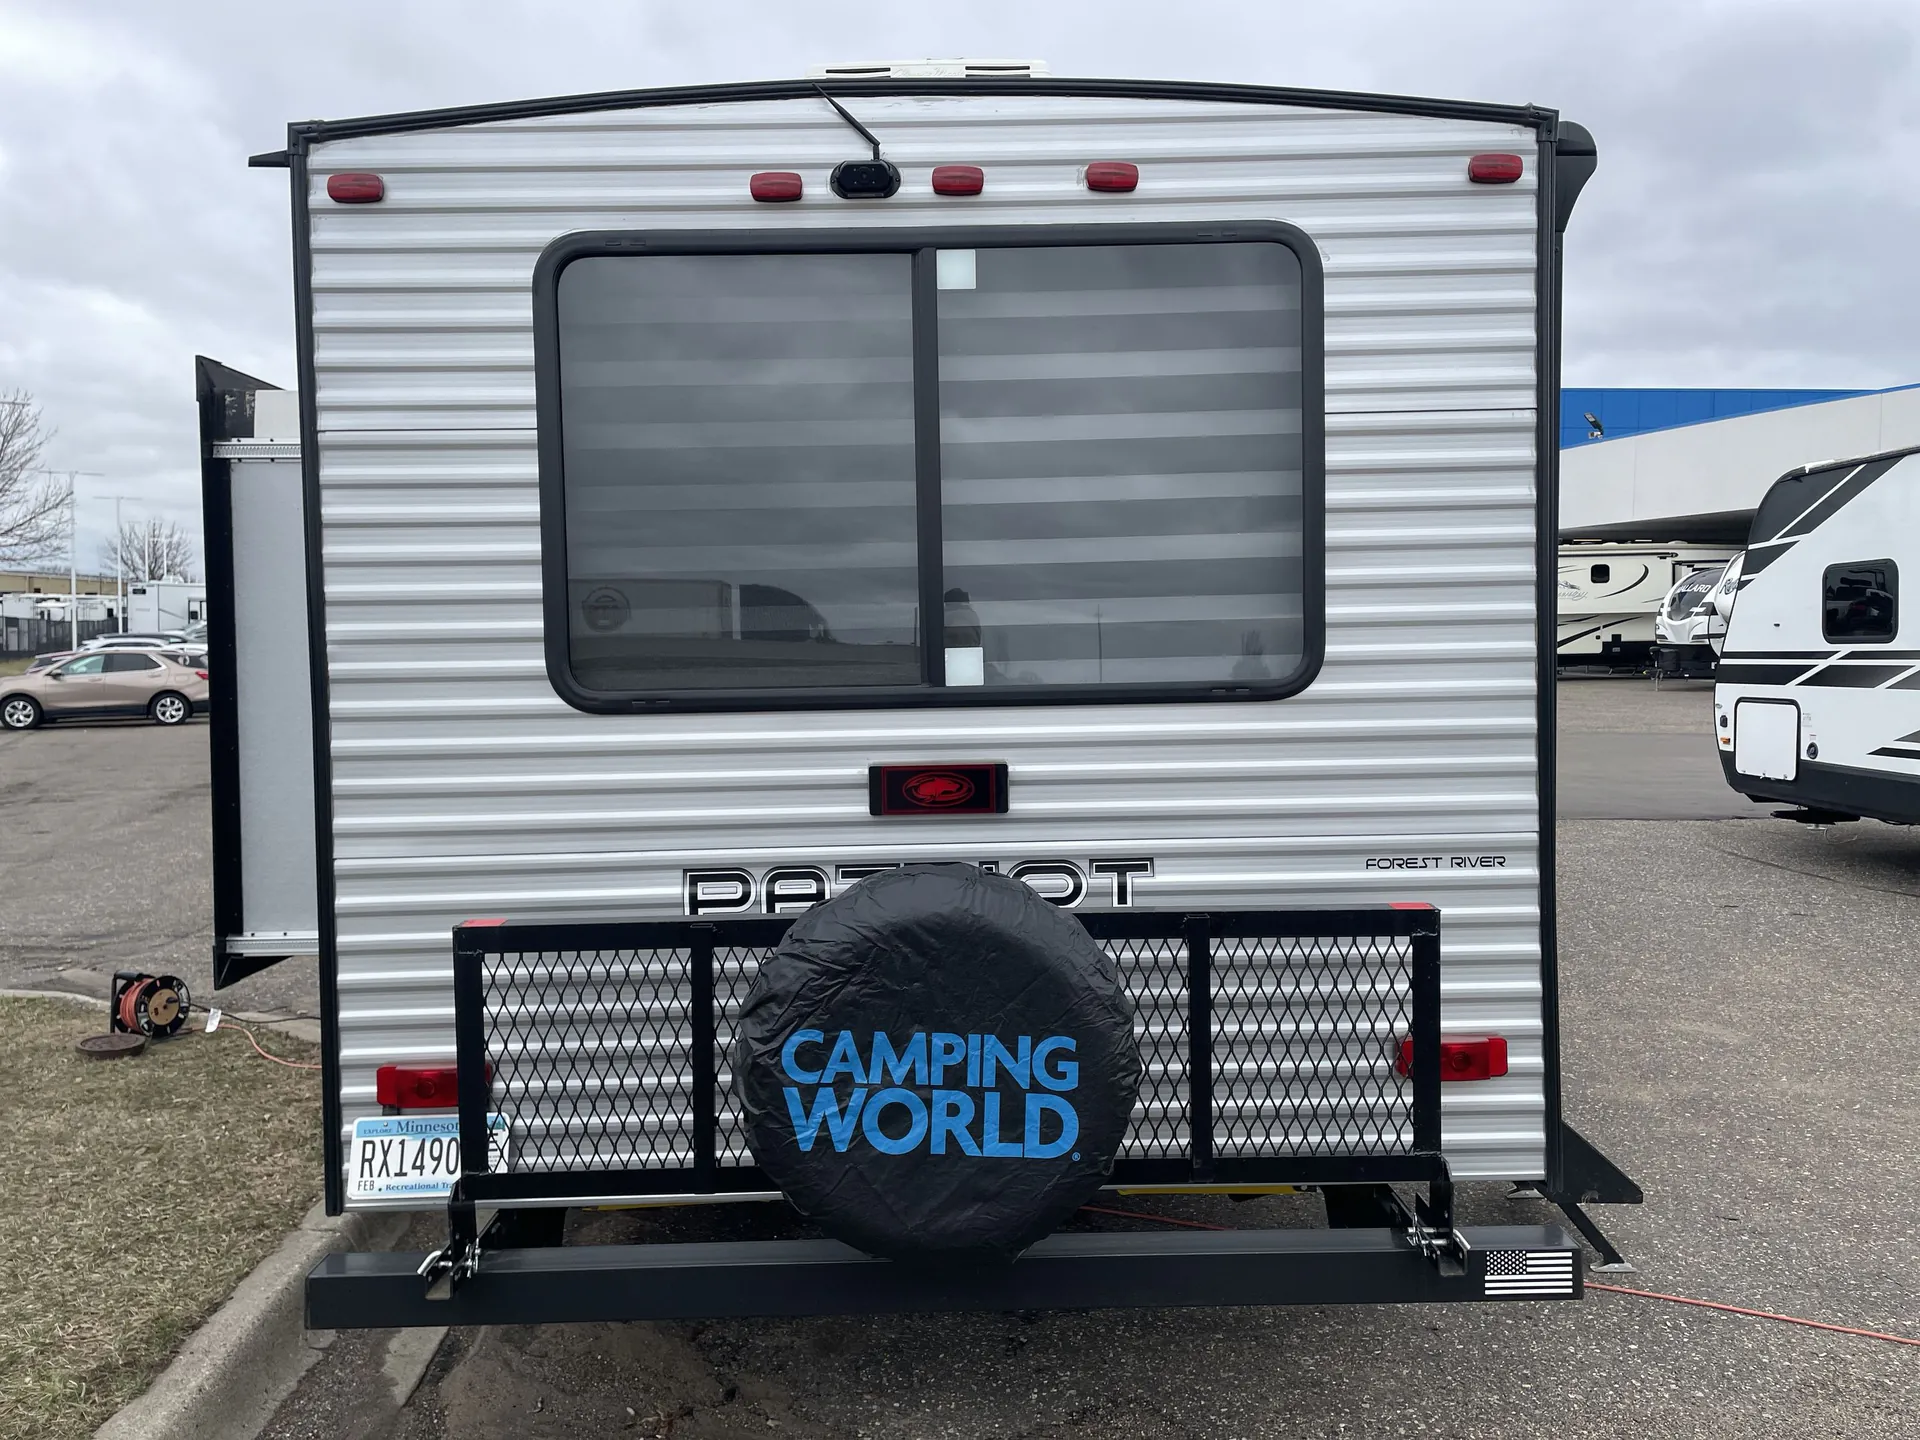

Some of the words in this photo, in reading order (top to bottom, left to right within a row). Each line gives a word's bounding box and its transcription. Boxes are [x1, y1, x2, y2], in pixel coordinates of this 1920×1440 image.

[1366, 857, 1442, 870] FOREST
[1451, 856, 1506, 868] RIVER
[683, 857, 1155, 916] PAOT
[781, 1029, 1079, 1091] CAMPING
[396, 1120, 460, 1133] Minnesot
[782, 1087, 1079, 1160] WORLD
[357, 1180, 375, 1191] FEB
[385, 1182, 439, 1191] Recreational
